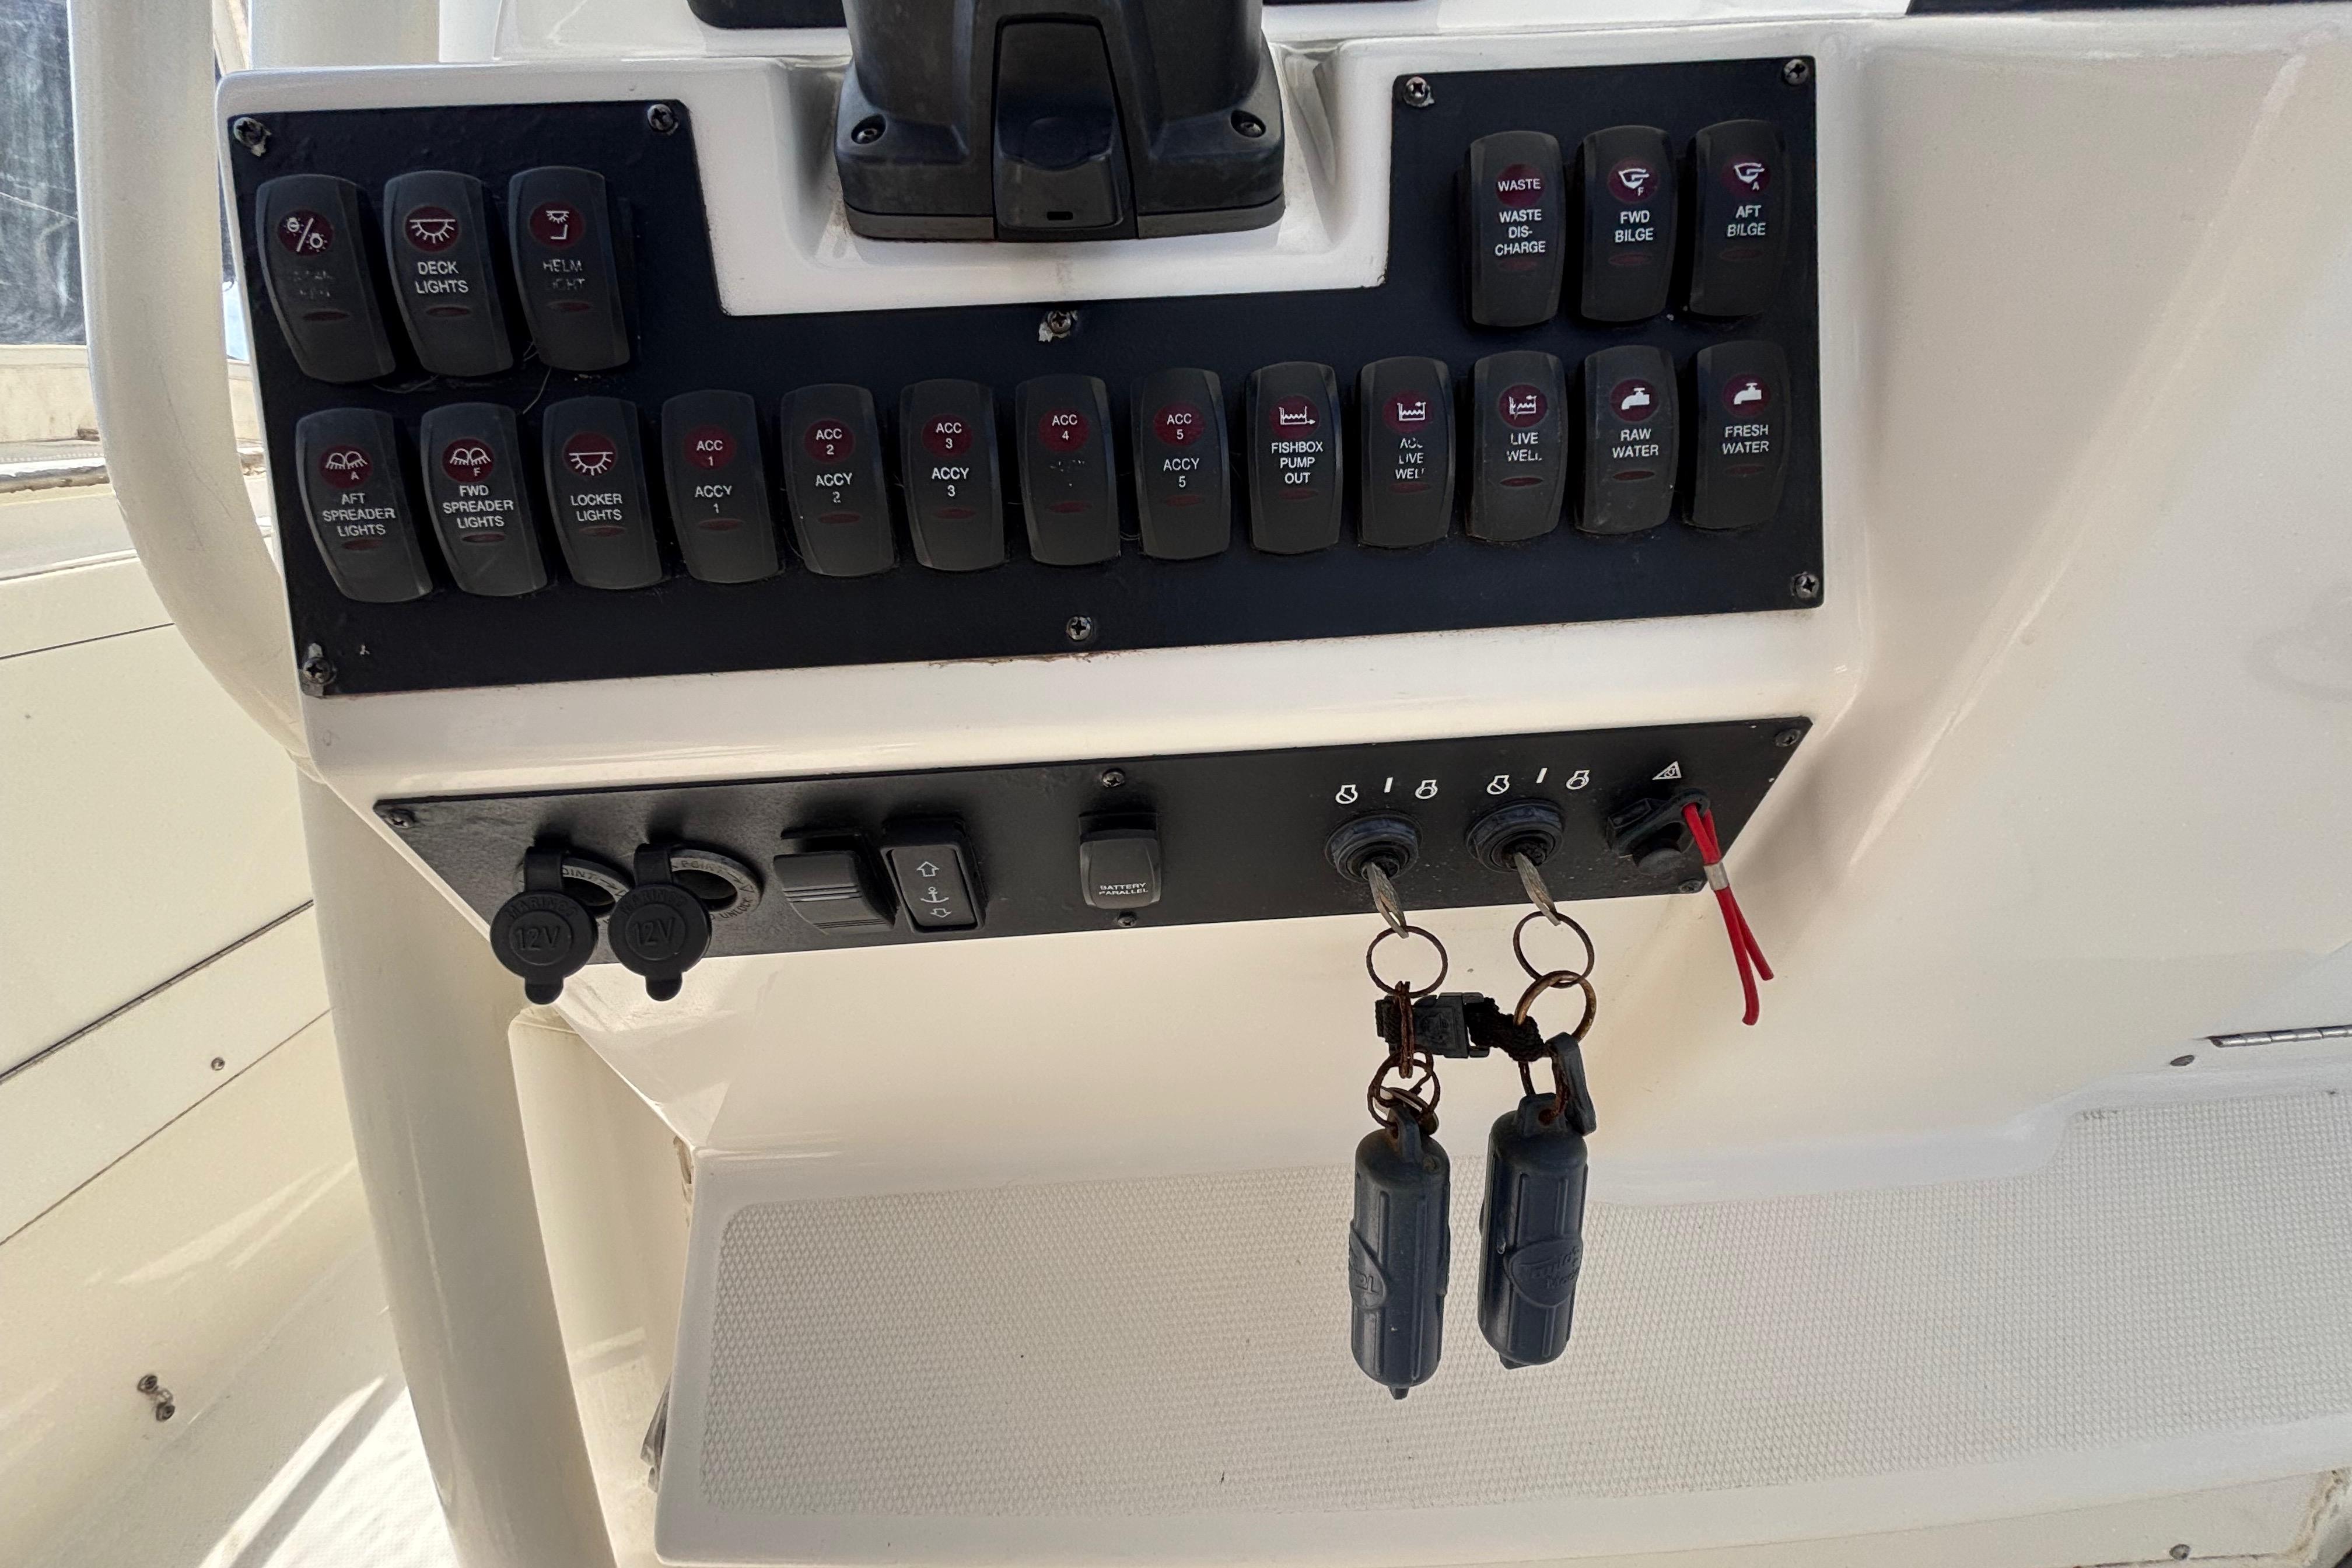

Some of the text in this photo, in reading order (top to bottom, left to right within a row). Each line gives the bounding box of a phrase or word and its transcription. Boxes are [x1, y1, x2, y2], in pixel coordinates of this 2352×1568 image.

[1497, 178, 1541, 192] WASTE
[1499, 209, 1542, 223] WASTE
[1620, 209, 1650, 224] FWD
[1735, 205, 1762, 219] AFT
[1508, 225, 1533, 239] DIS-
[1615, 227, 1654, 243] BILGE
[1727, 222, 1766, 237] BILGE
[1494, 240, 1546, 256] CHARGE
[417, 261, 459, 275] DECK
[542, 258, 583, 272] HELM
[415, 279, 469, 294] LIGHTS
[1052, 414, 1078, 426] ACC
[1167, 413, 1192, 425] ACC
[816, 428, 842, 440] ACC
[936, 422, 962, 434] ACC
[1177, 429, 1184, 440] 5
[1725, 424, 1769, 438] FRESH
[1062, 430, 1069, 440] 4
[1510, 432, 1539, 445] LIVE
[1620, 428, 1651, 442] RAW
[696, 440, 723, 452] ACC
[826, 444, 834, 455] 2
[1271, 441, 1324, 454] FISHBOX
[1612, 444, 1659, 459] WATER
[1722, 440, 1769, 455] WATER
[708, 456, 713, 466] 1
[1163, 457, 1199, 471] ACCY
[1280, 456, 1315, 469] PUMP
[1399, 452, 1424, 464] LIVE
[815, 473, 853, 487] ACCY
[931, 467, 970, 480] ACCY
[1284, 471, 1311, 484] OUT
[1178, 475, 1186, 488] 5
[459, 485, 489, 497] FWD
[695, 485, 732, 498] ACCY
[832, 491, 841, 503] 2
[947, 484, 956, 497] 3
[341, 492, 365, 505] AFT
[570, 492, 623, 506] LOCKER
[442, 499, 514, 514] SPREADER
[713, 503, 719, 514] 1
[322, 508, 396, 522] SPREADER
[576, 509, 622, 522] LIGHTS
[456, 515, 505, 529] LIGHTS
[336, 524, 386, 537] LIGHTS
[1100, 882, 1146, 890] BATTERY
[719, 897, 754, 919] UNLOCK
[632, 916, 676, 947] 12V
[516, 926, 560, 951] 12V
